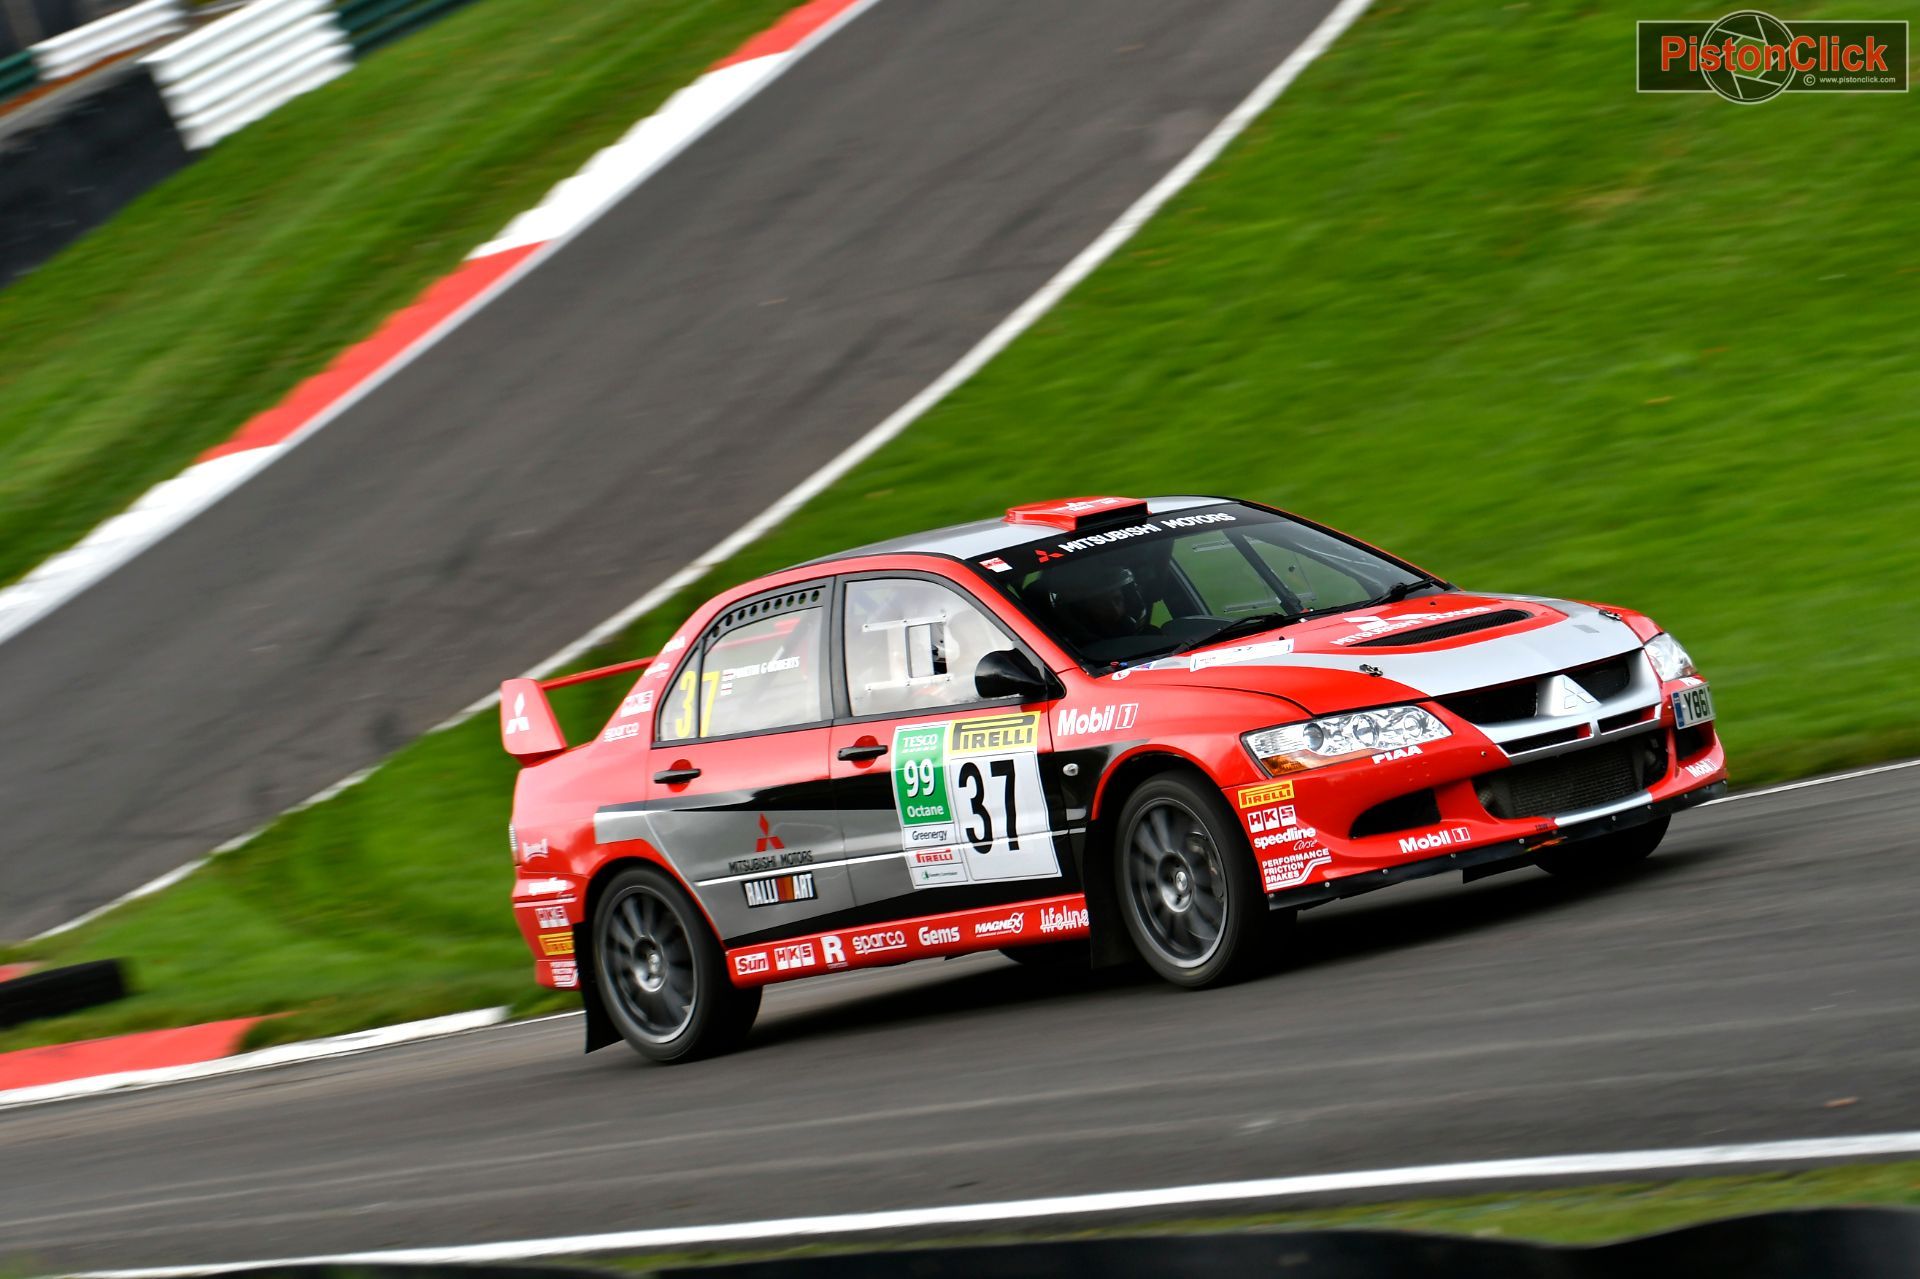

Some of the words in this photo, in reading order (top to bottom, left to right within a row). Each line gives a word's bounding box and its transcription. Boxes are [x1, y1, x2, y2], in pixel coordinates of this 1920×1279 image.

[1058, 523, 1163, 553] MITSUBISHI
[1161, 512, 1236, 530] MOTORS
[676, 671, 721, 738] 37
[1057, 704, 1116, 737] Mobil
[902, 733, 938, 747] TESCO
[951, 714, 1036, 751] PIRELLI
[1372, 745, 1423, 765] PIAA
[903, 758, 936, 798] 99
[958, 759, 1020, 854] 37
[1240, 783, 1291, 807] PIRELLI
[906, 805, 945, 818] Octane
[1249, 806, 1295, 828] HKS
[912, 830, 948, 841] Greenergy
[1253, 826, 1317, 850] speedline
[1398, 829, 1452, 854] Mobil
[728, 855, 777, 874] MITSUBISHI
[780, 850, 814, 867] MOTORS
[915, 848, 953, 864] PIRELLI
[1261, 847, 1330, 869] PERFORMANCE
[1263, 860, 1304, 876] FRICTION
[1265, 872, 1300, 884] BRAKES
[974, 911, 1024, 934] MAGNEX
[852, 930, 906, 954] sparco
[918, 926, 961, 946] Gems
[775, 944, 814, 966] HKS
[820, 935, 846, 964] R
